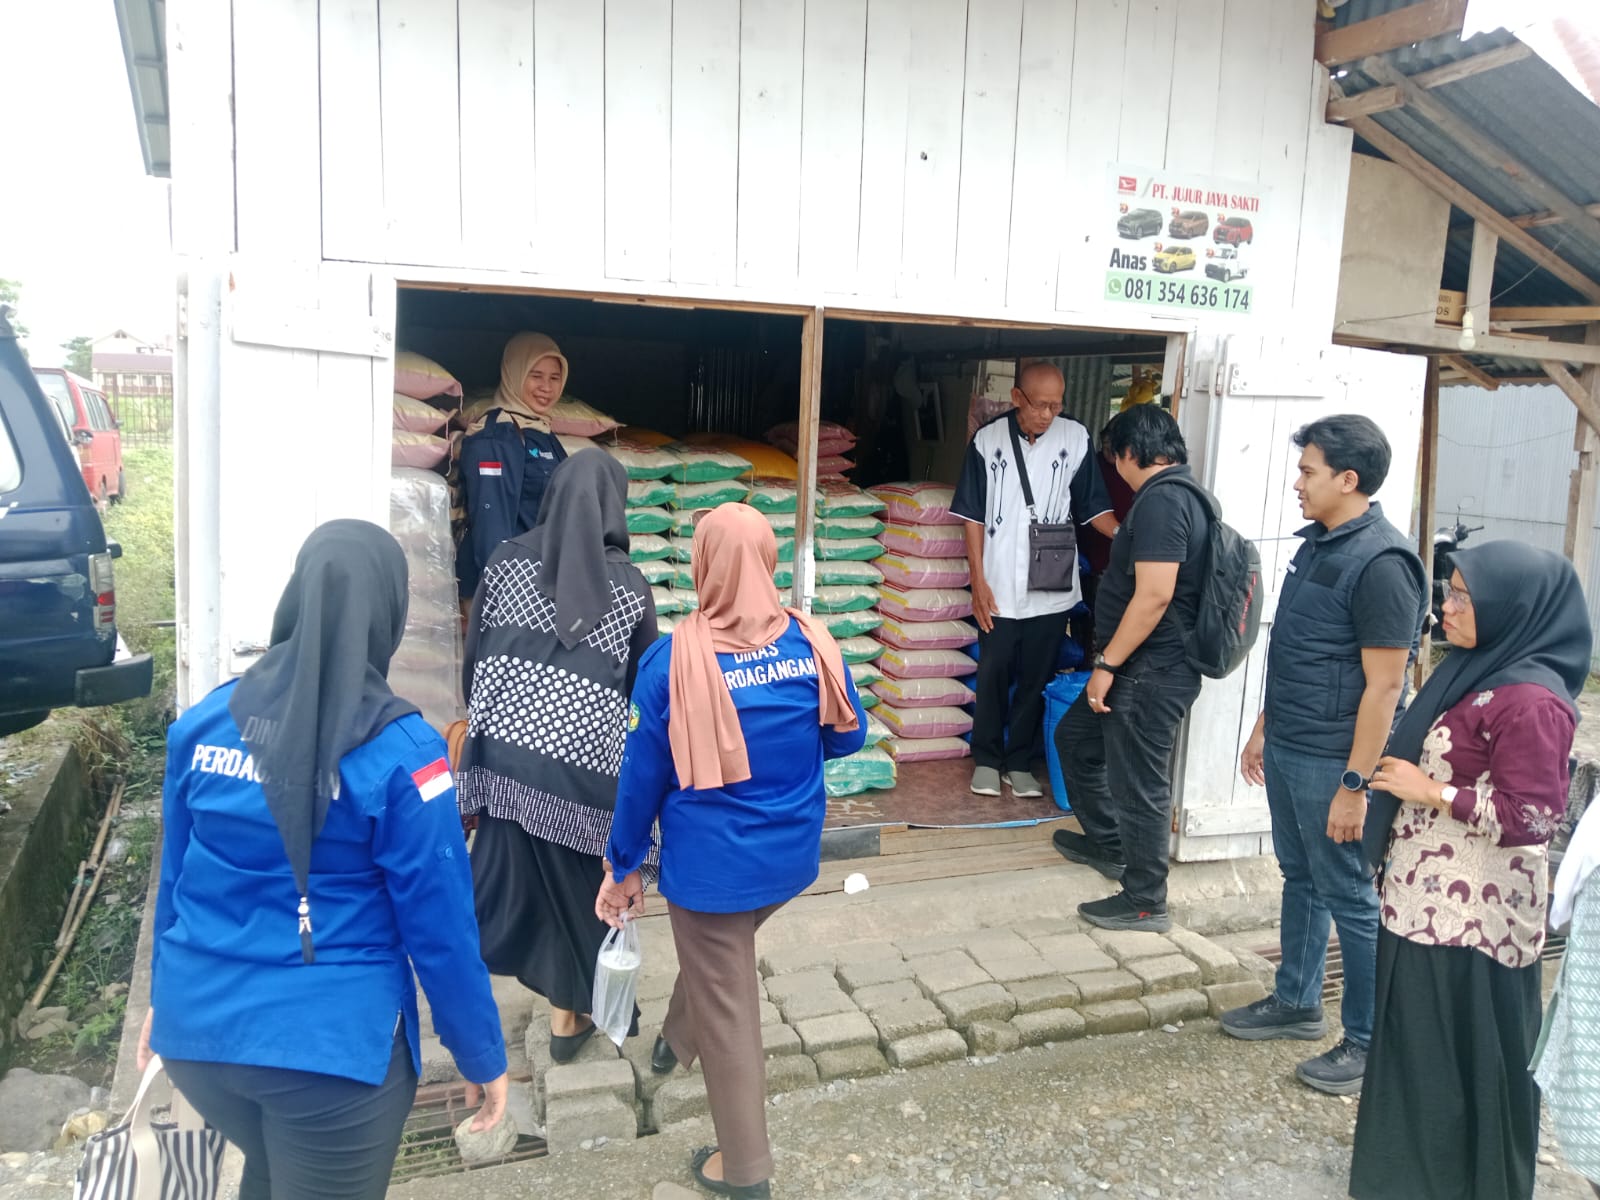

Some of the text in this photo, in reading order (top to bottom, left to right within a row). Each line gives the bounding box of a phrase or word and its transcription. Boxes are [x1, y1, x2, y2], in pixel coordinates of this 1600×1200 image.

[1151, 183, 1169, 200] PT.
[1171, 186, 1203, 204] JUJUR
[1204, 191, 1229, 209] JAYA
[1230, 195, 1260, 212] SAKTI
[1109, 247, 1148, 272] Anas
[1125, 278, 1249, 310] 081 354 636 174
